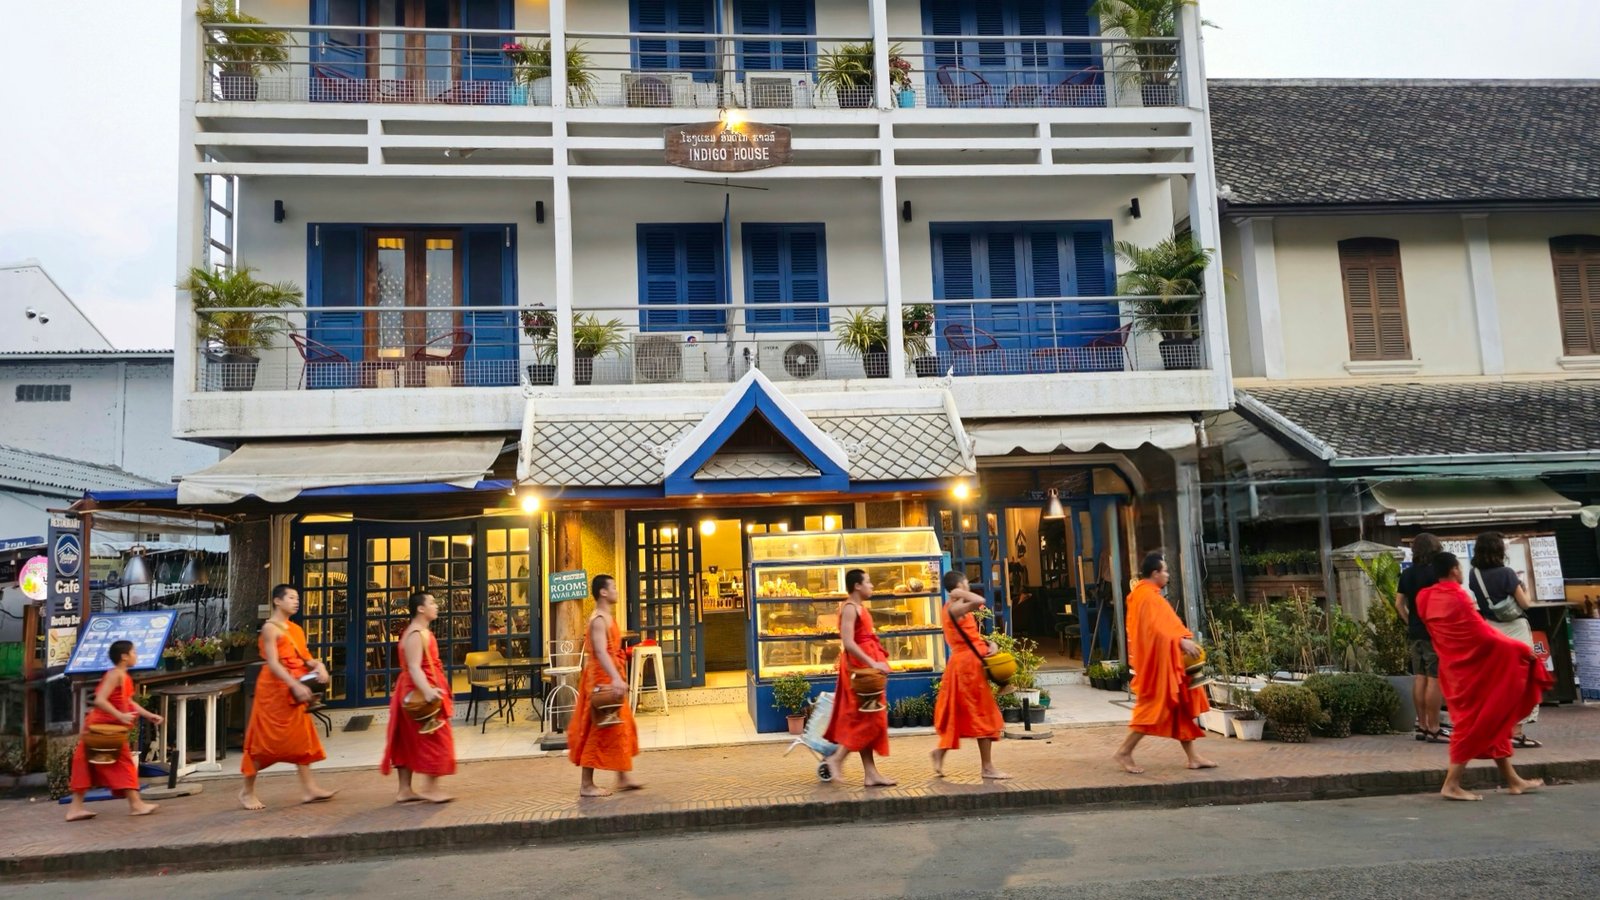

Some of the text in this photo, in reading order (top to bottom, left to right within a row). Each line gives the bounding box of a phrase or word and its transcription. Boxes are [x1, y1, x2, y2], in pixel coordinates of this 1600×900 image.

[689, 147, 770, 161] INDIGO HOUSE
[55, 579, 80, 594] Café
[550, 581, 588, 593] ROOMS
[551, 590, 587, 600] AVAILABLE
[64, 597, 73, 610] &
[71, 615, 81, 625] Bar
